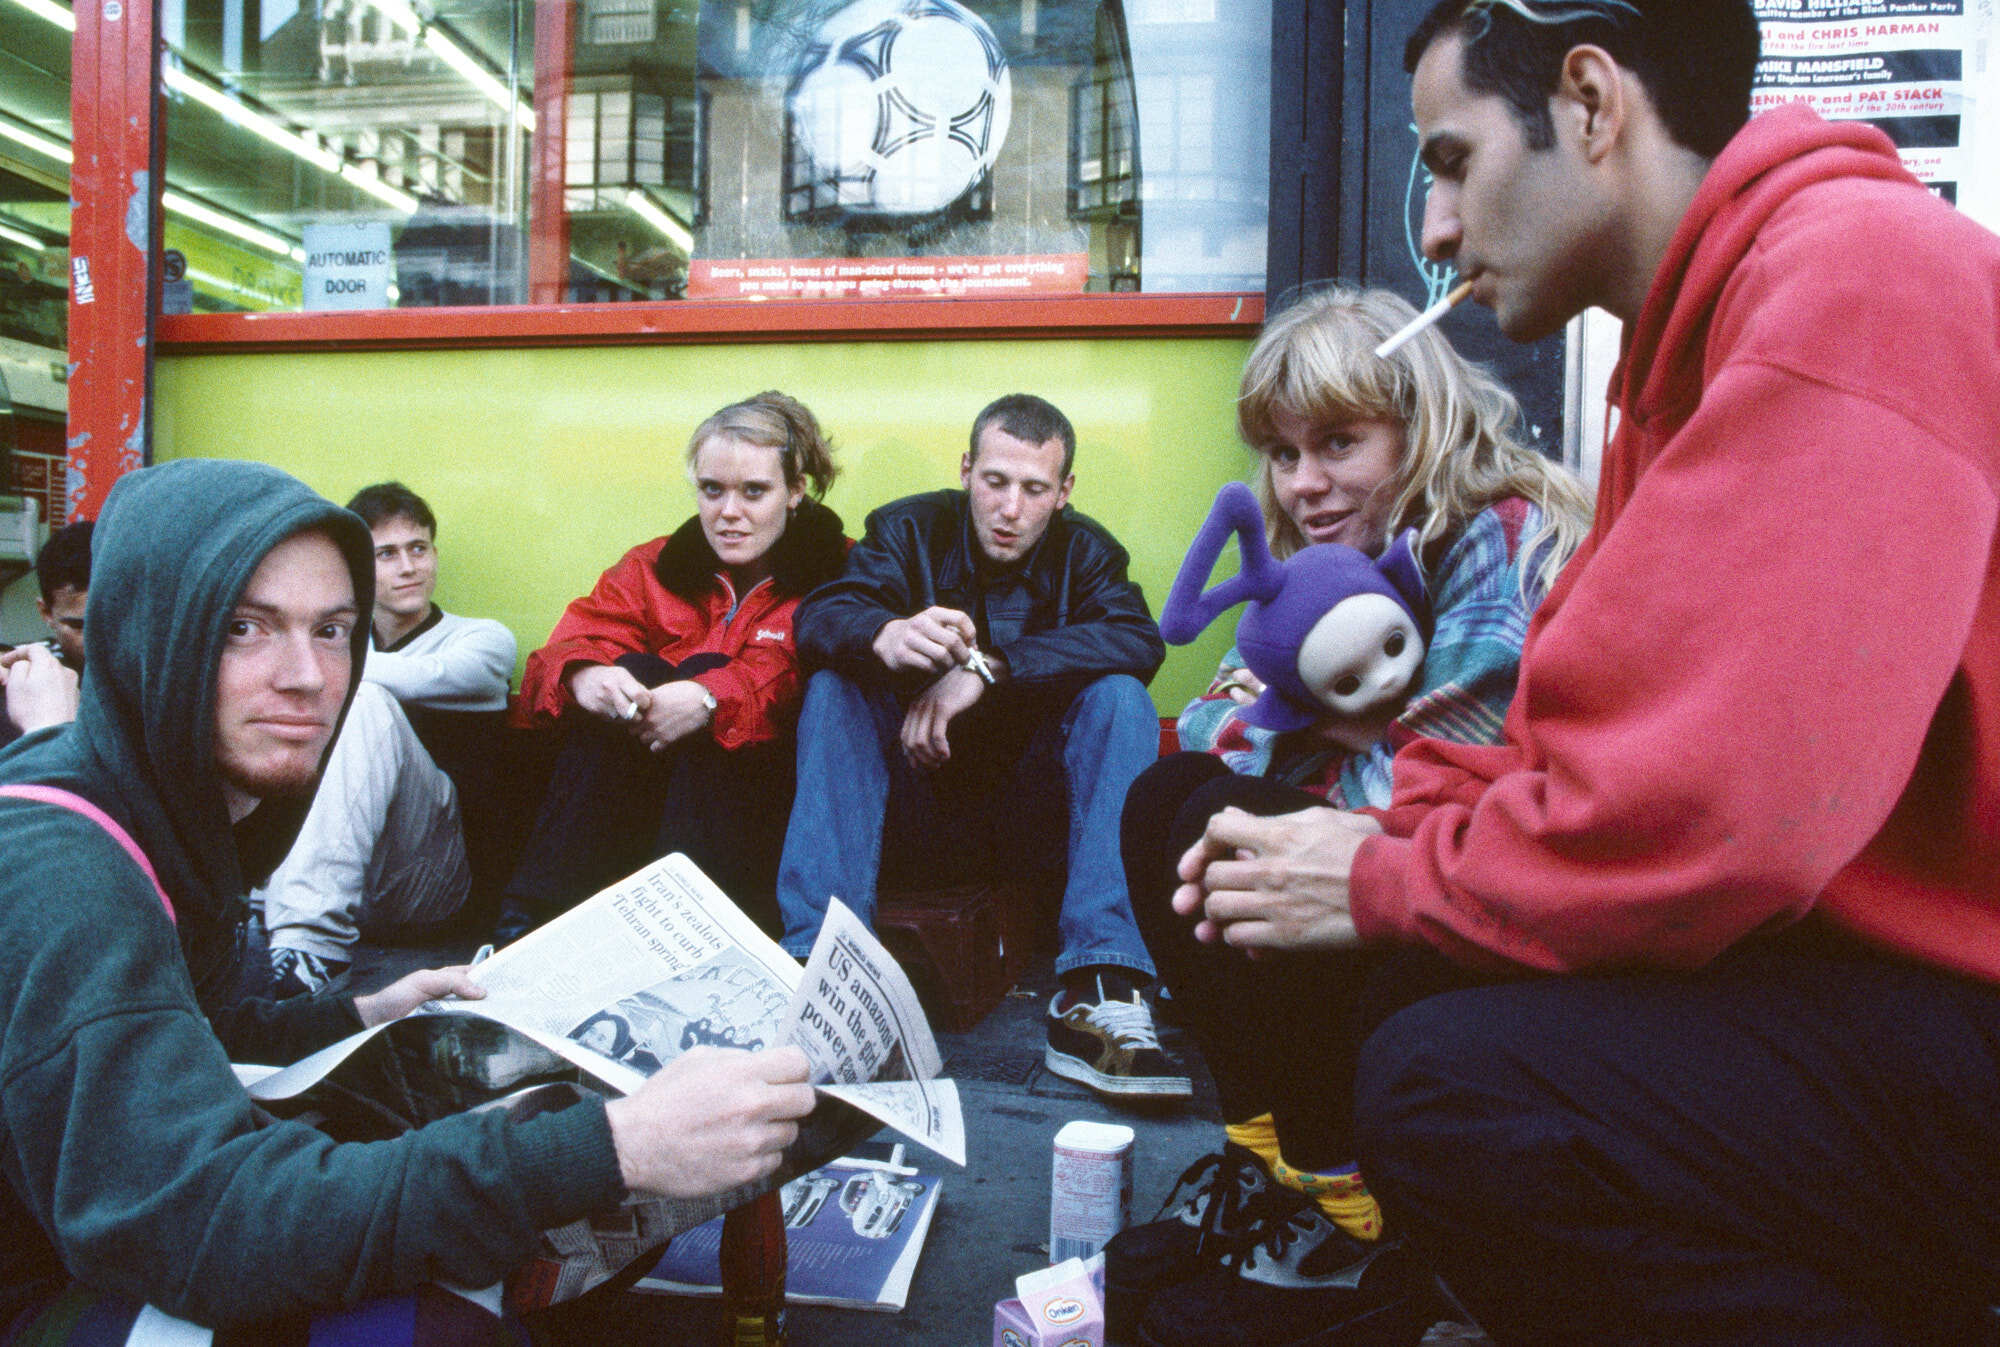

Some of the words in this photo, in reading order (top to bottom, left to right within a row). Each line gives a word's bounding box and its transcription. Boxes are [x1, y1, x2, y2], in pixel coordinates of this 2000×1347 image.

[1830, 8, 1840, 16] of
[1890, 3, 1928, 12] Panther
[1930, 2, 1956, 12] Party
[1778, 30, 1804, 40] and
[1812, 26, 1858, 40] CHRIS
[1866, 23, 1940, 36] HARMAN
[1757, 60, 1792, 73] MIKE
[1796, 57, 1884, 72] MANSFIELD
[1778, 74, 1811, 84] Stephen
[1822, 94, 1852, 104] and
[1859, 91, 1888, 102] PAT
[1894, 88, 1942, 100] STACK
[309, 250, 386, 267] AUTOMATIC
[824, 264, 836, 276] of
[838, 264, 894, 276] man-sized
[897, 264, 935, 275] tissues
[946, 263, 980, 274] we've
[982, 264, 1002, 276] got
[1005, 262, 1064, 276] everything
[326, 280, 366, 294] DOOR
[739, 281, 760, 293] you
[792, 279, 804, 290] to
[836, 281, 856, 292] you
[859, 280, 890, 292] going
[893, 278, 938, 291] through
[648, 872, 683, 910] Iran's
[680, 909, 722, 950] zealots
[630, 886, 664, 919] fight
[660, 916, 675, 932] to
[673, 932, 704, 960] curb
[828, 945, 852, 982] US
[850, 978, 895, 1050] amazons
[800, 1000, 849, 1060] power
[818, 977, 846, 1016] win
[850, 1008, 866, 1044] the
[858, 1034, 881, 1072] girl
[1048, 1303, 1080, 1318] Onken
